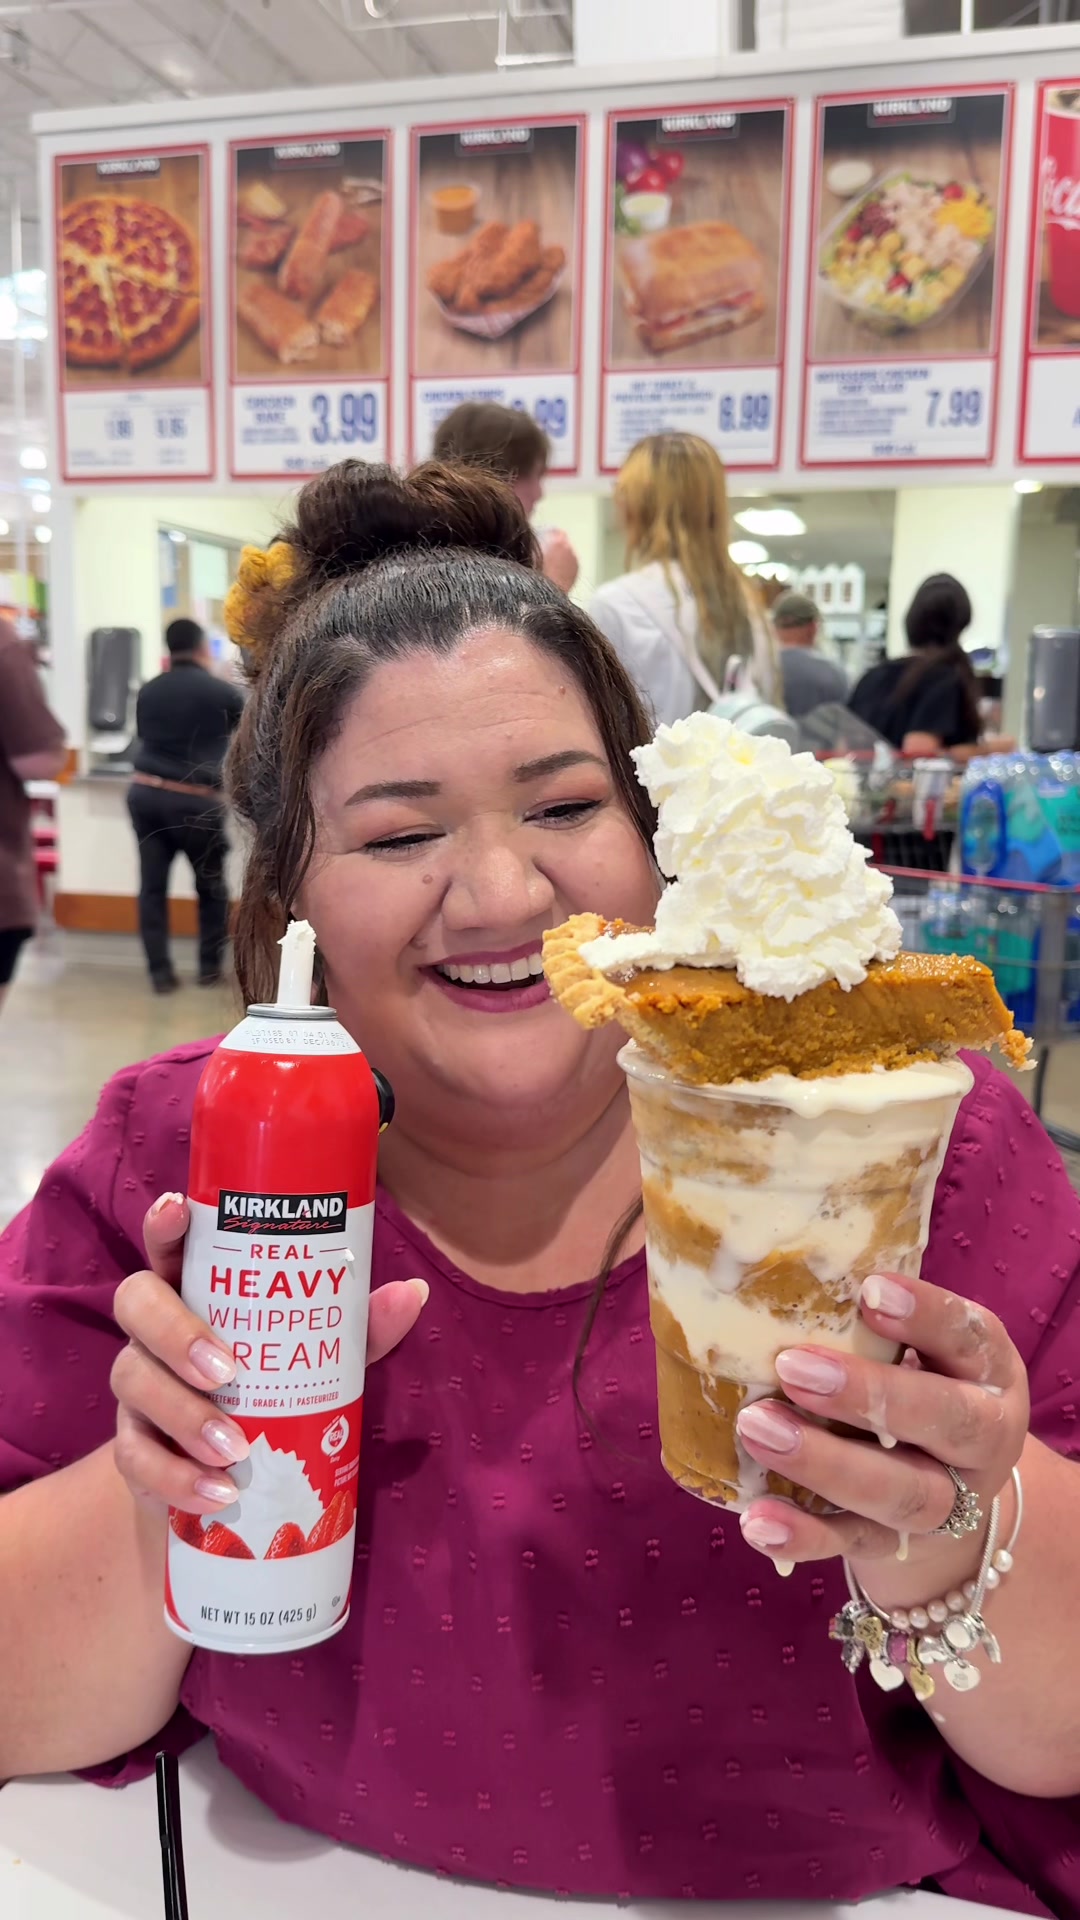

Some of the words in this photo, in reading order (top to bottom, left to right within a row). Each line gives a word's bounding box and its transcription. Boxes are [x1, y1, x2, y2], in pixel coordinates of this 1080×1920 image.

[311, 393, 377, 443] 3.99
[927, 389, 982, 427] 7.99
[224, 1195, 344, 1219] KIRKLAND
[224, 1216, 342, 1235] Signature
[250, 1243, 315, 1260] REAL
[210, 1265, 347, 1299] HEAVY
[208, 1303, 342, 1332] WHIPPED
[233, 1337, 341, 1371] REAM
[208, 1393, 240, 1406] EETENED
[252, 1398, 278, 1408] GRADE
[279, 1398, 286, 1408] A
[296, 1391, 340, 1407] PASTEURIZED
[200, 1605, 220, 1622] NET
[223, 1609, 240, 1625] WT
[244, 1612, 256, 1625] 15
[260, 1611, 274, 1625] OZ
[278, 1607, 303, 1626] (425
[306, 1603, 317, 1621] g)
